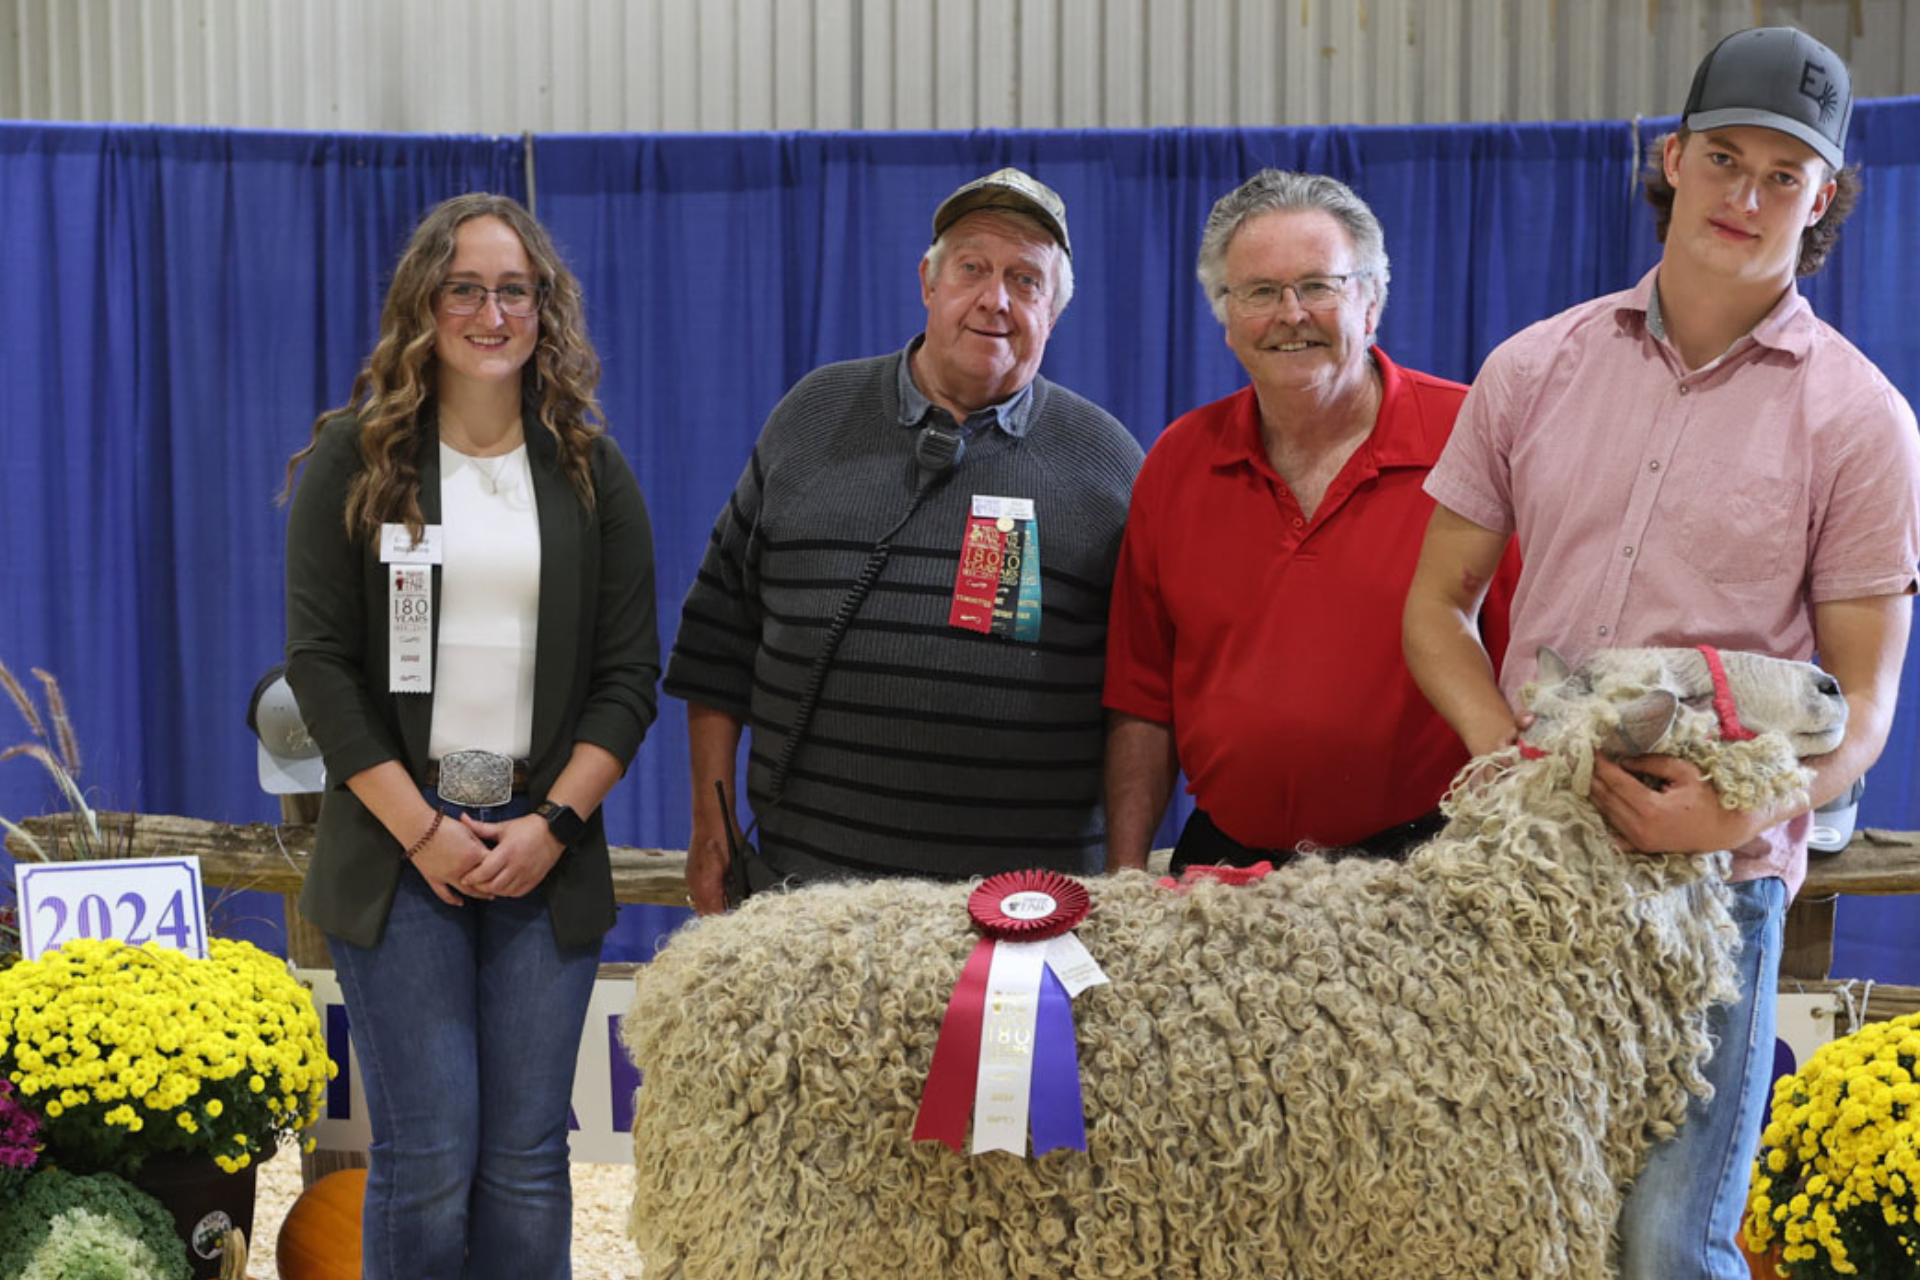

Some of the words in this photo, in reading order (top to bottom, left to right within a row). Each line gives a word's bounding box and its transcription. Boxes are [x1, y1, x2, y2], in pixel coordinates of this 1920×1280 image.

[964, 547, 1001, 567] 180
[394, 597, 429, 616] 180
[394, 615, 429, 624] YEARS
[37, 889, 191, 951] 2024
[988, 1025, 1031, 1046] 180
